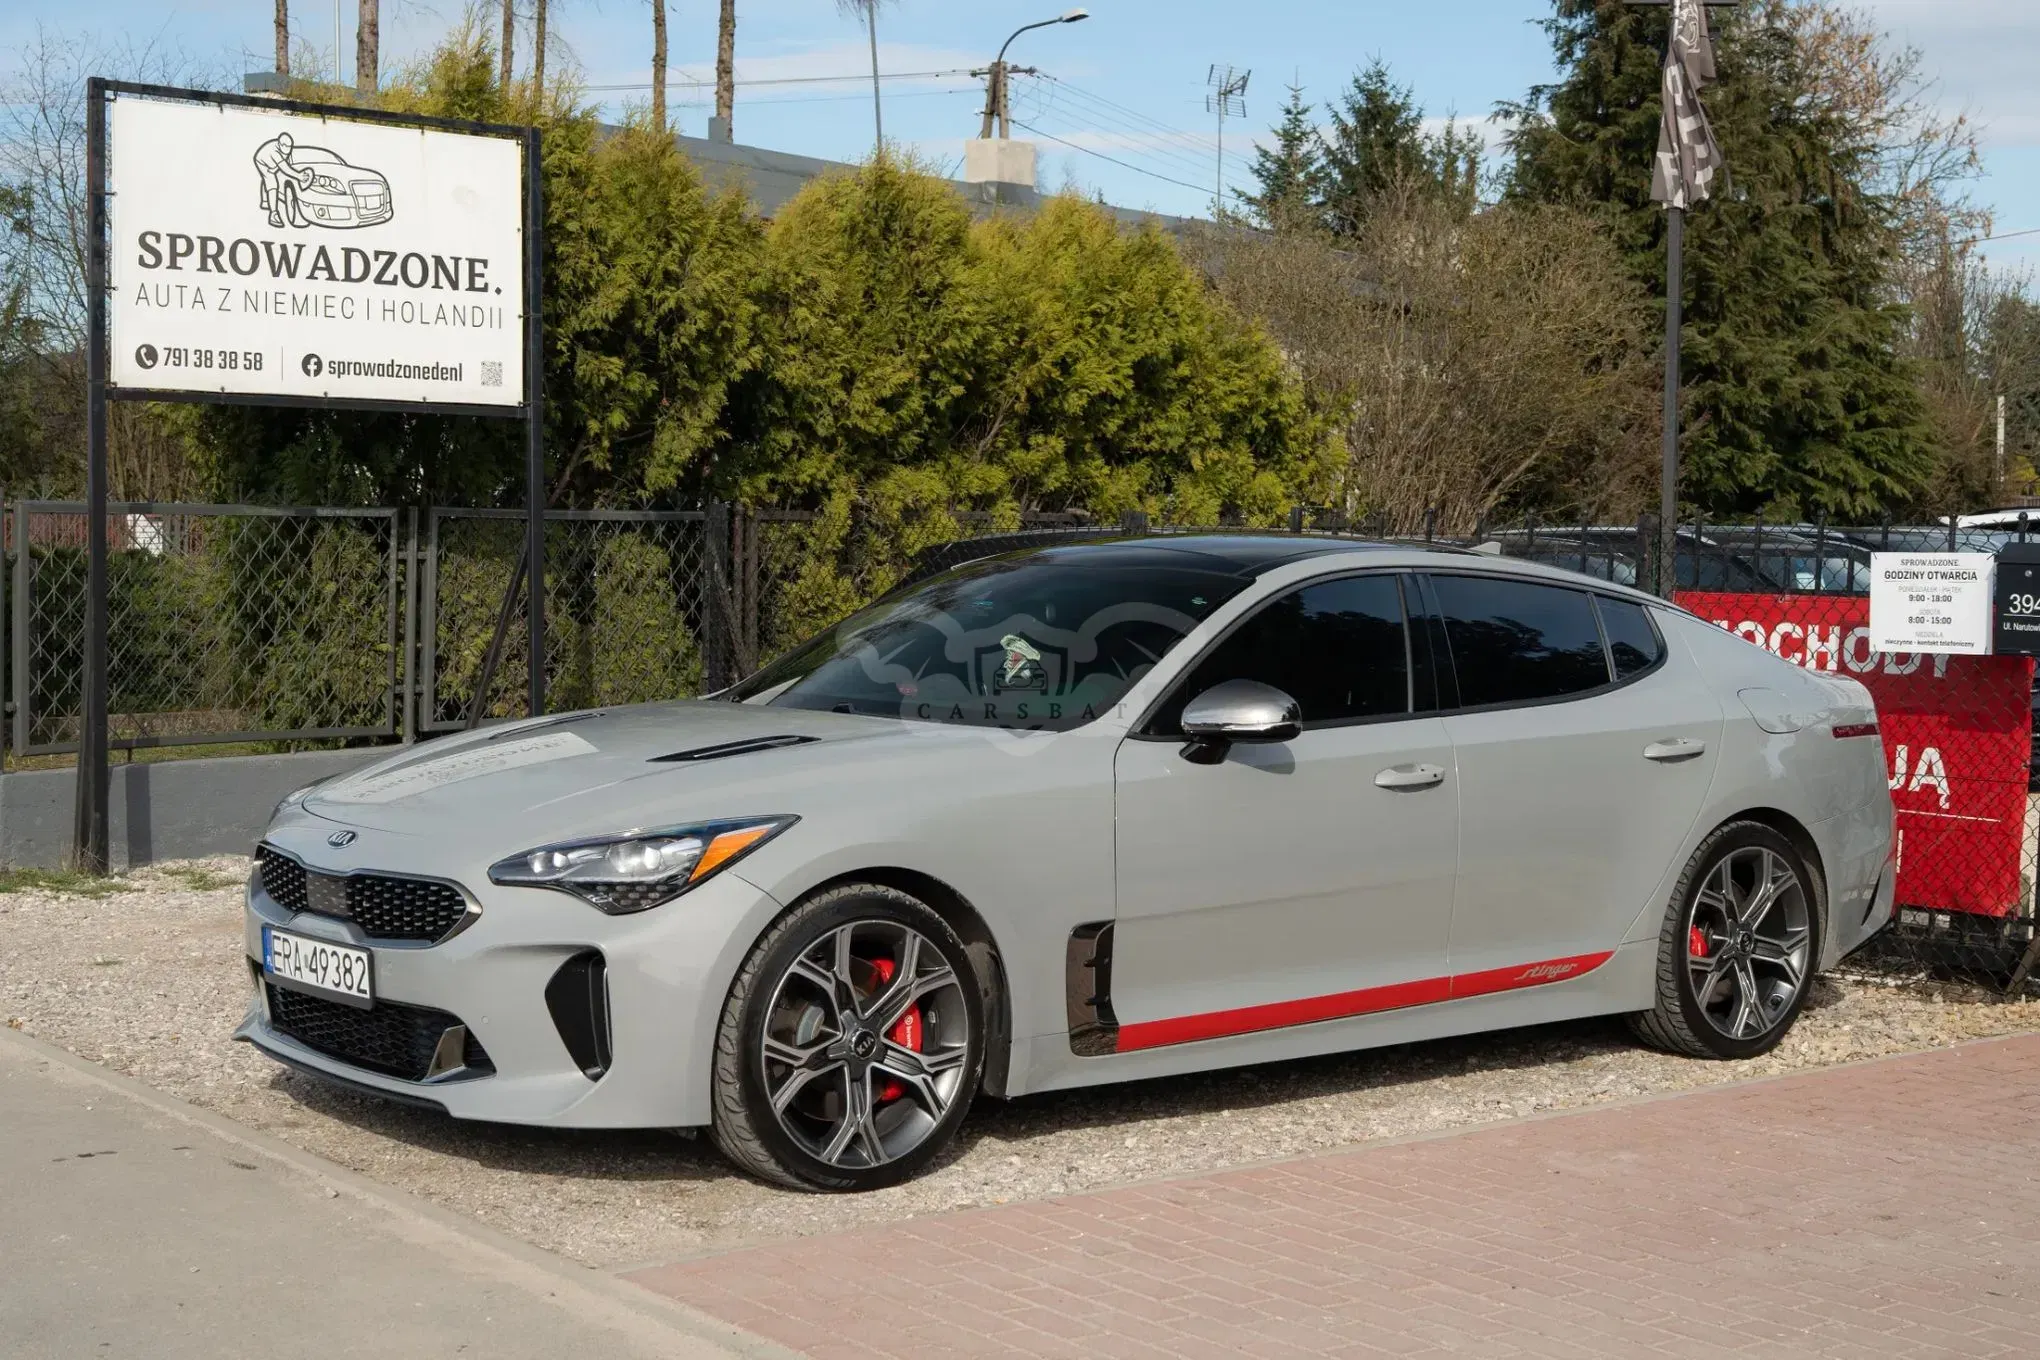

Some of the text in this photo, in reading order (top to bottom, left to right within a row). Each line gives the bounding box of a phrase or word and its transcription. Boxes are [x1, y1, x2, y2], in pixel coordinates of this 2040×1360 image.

[138, 231, 502, 295] SPROWADZONE.
[135, 282, 502, 329] AUTA Z NIEMIEC I HOLANDII
[163, 347, 263, 371] 791 38 38 58
[328, 359, 463, 382] sprowadzonedenl
[1884, 570, 1978, 580] GODZINY OTWARCIA
[1908, 594, 1925, 602] 9:00
[1908, 616, 1925, 624] 8:00
[1931, 617, 1952, 625] 15:00
[1712, 619, 1950, 678] OCHO
[1885, 638, 1913, 646] nieczynne
[1939, 640, 1975, 648] telefoniczny
[328, 831, 356, 846] KIA
[272, 935, 368, 995] ERA 49382
